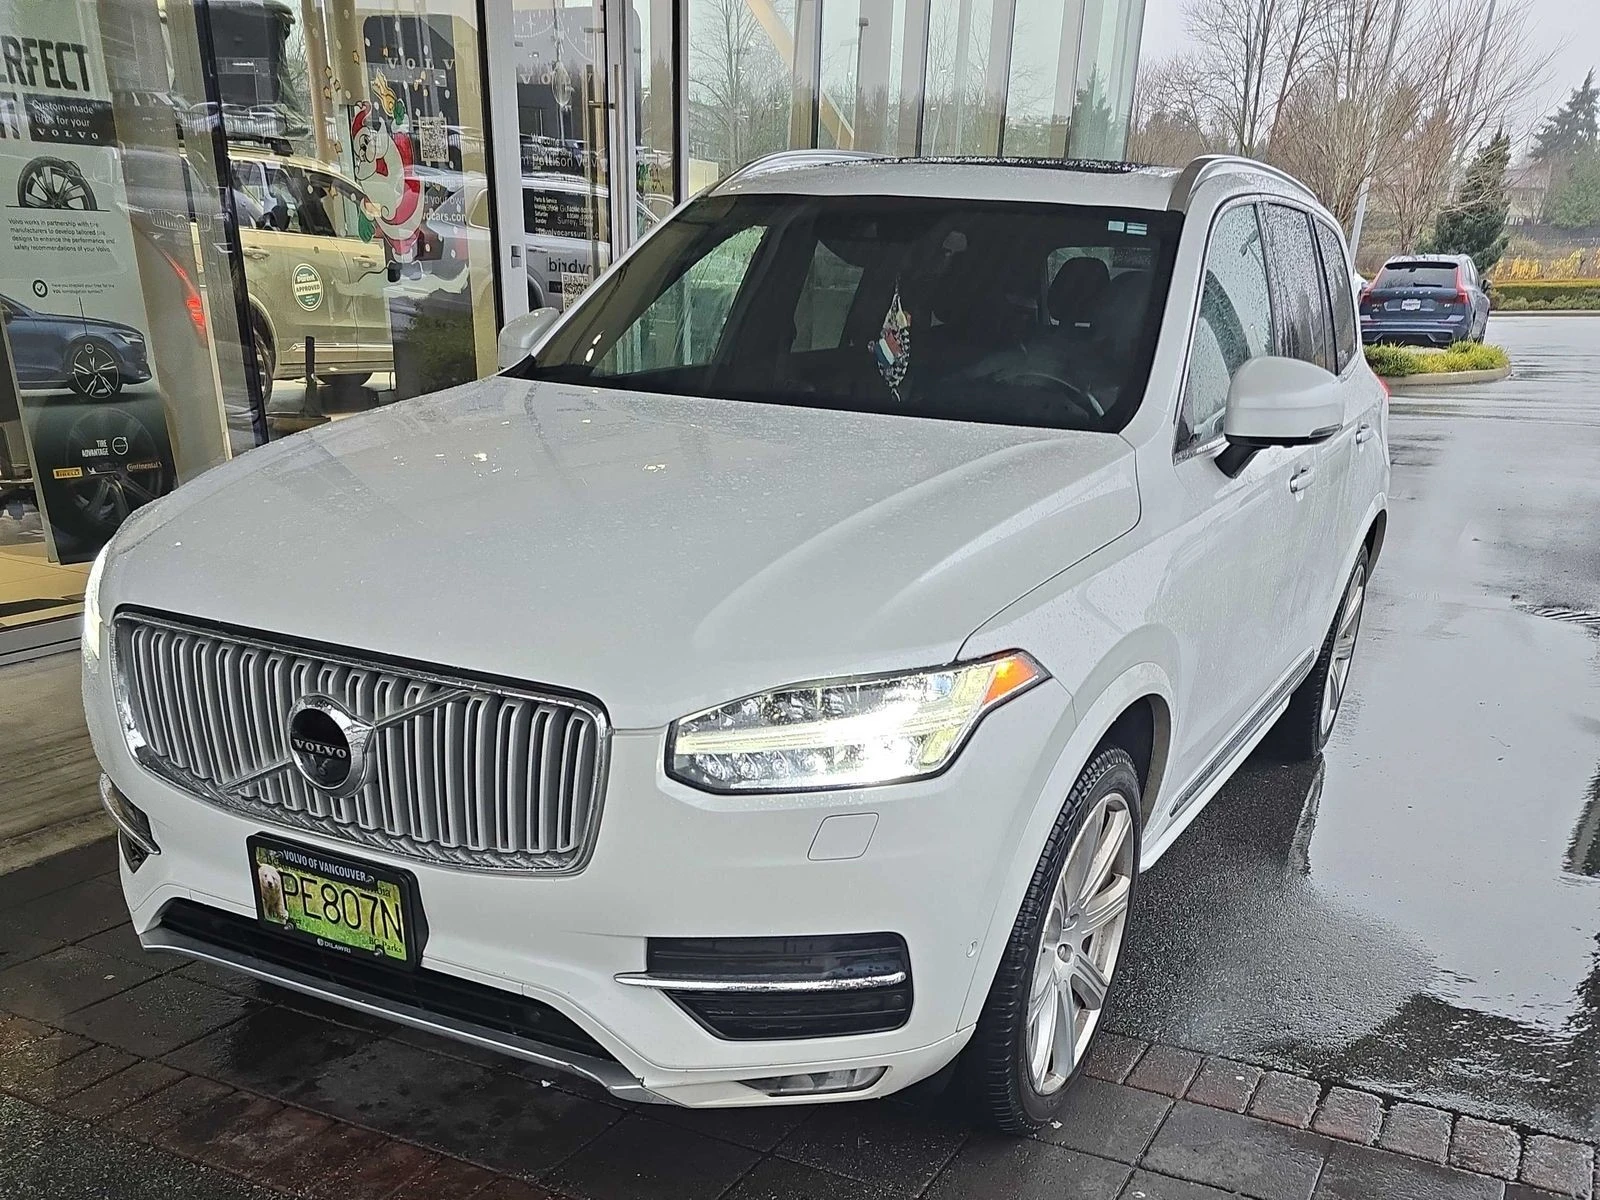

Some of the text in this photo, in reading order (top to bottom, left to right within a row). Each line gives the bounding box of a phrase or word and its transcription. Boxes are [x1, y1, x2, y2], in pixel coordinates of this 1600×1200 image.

[0, 35, 90, 92] RFECT
[56, 115, 68, 125] for
[70, 118, 90, 128] your
[37, 127, 98, 140] VOLVO
[46, 220, 77, 228] partnership
[81, 448, 109, 458] ADVANTAGE
[293, 738, 347, 759] VOLVO
[283, 849, 308, 866] VOLVO
[308, 859, 319, 869] OF
[319, 860, 367, 882] VANCOUVER
[280, 870, 404, 944] PE807N
[382, 939, 403, 953] Parks
